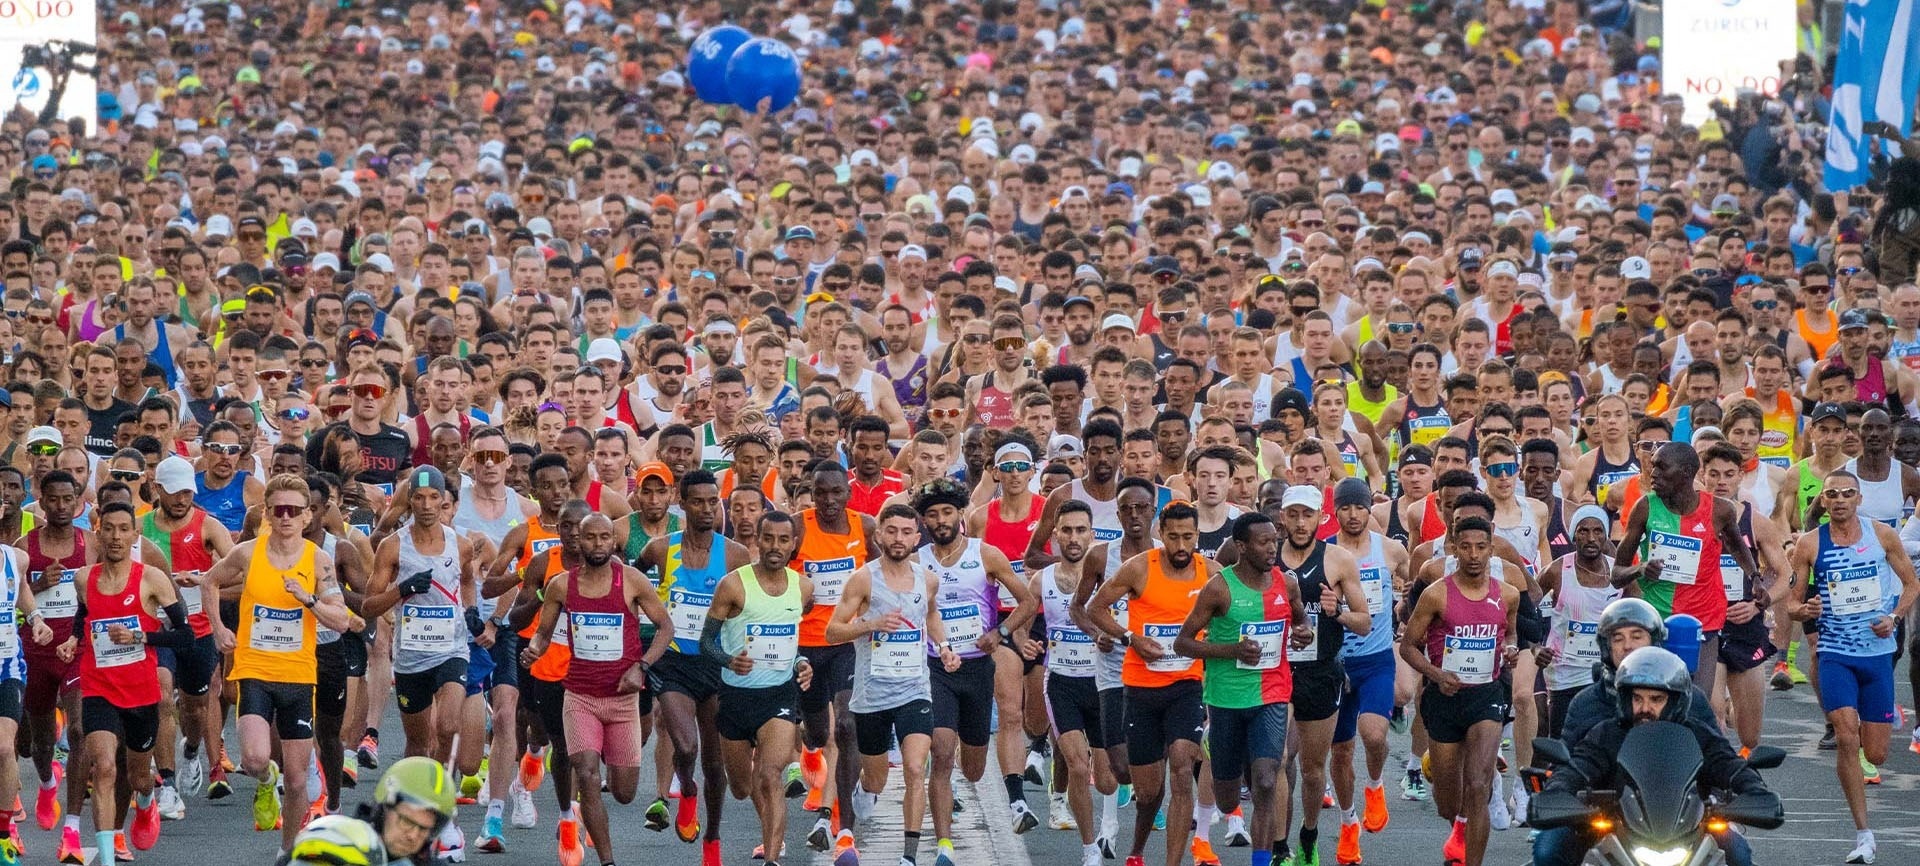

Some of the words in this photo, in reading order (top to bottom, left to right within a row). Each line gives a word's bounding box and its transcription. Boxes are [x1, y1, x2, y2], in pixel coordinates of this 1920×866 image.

[1690, 17, 1768, 33] ZURICH
[1667, 537, 1695, 548] ZURICH
[821, 561, 849, 571] ZURICH
[1845, 570, 1872, 579] ZURICH
[55, 590, 61, 598] 8
[270, 610, 298, 619] ZURICH
[421, 609, 449, 617] ZURICH
[945, 608, 973, 618] ZURICH
[588, 617, 617, 625] ZURICH
[1162, 628, 1180, 636] ZURI
[1258, 624, 1282, 633] ZURICH
[1454, 623, 1498, 638] POLIZIA
[891, 633, 918, 641] ZURICH
[1463, 641, 1491, 649] ZURICH
[1465, 656, 1475, 664] 43
